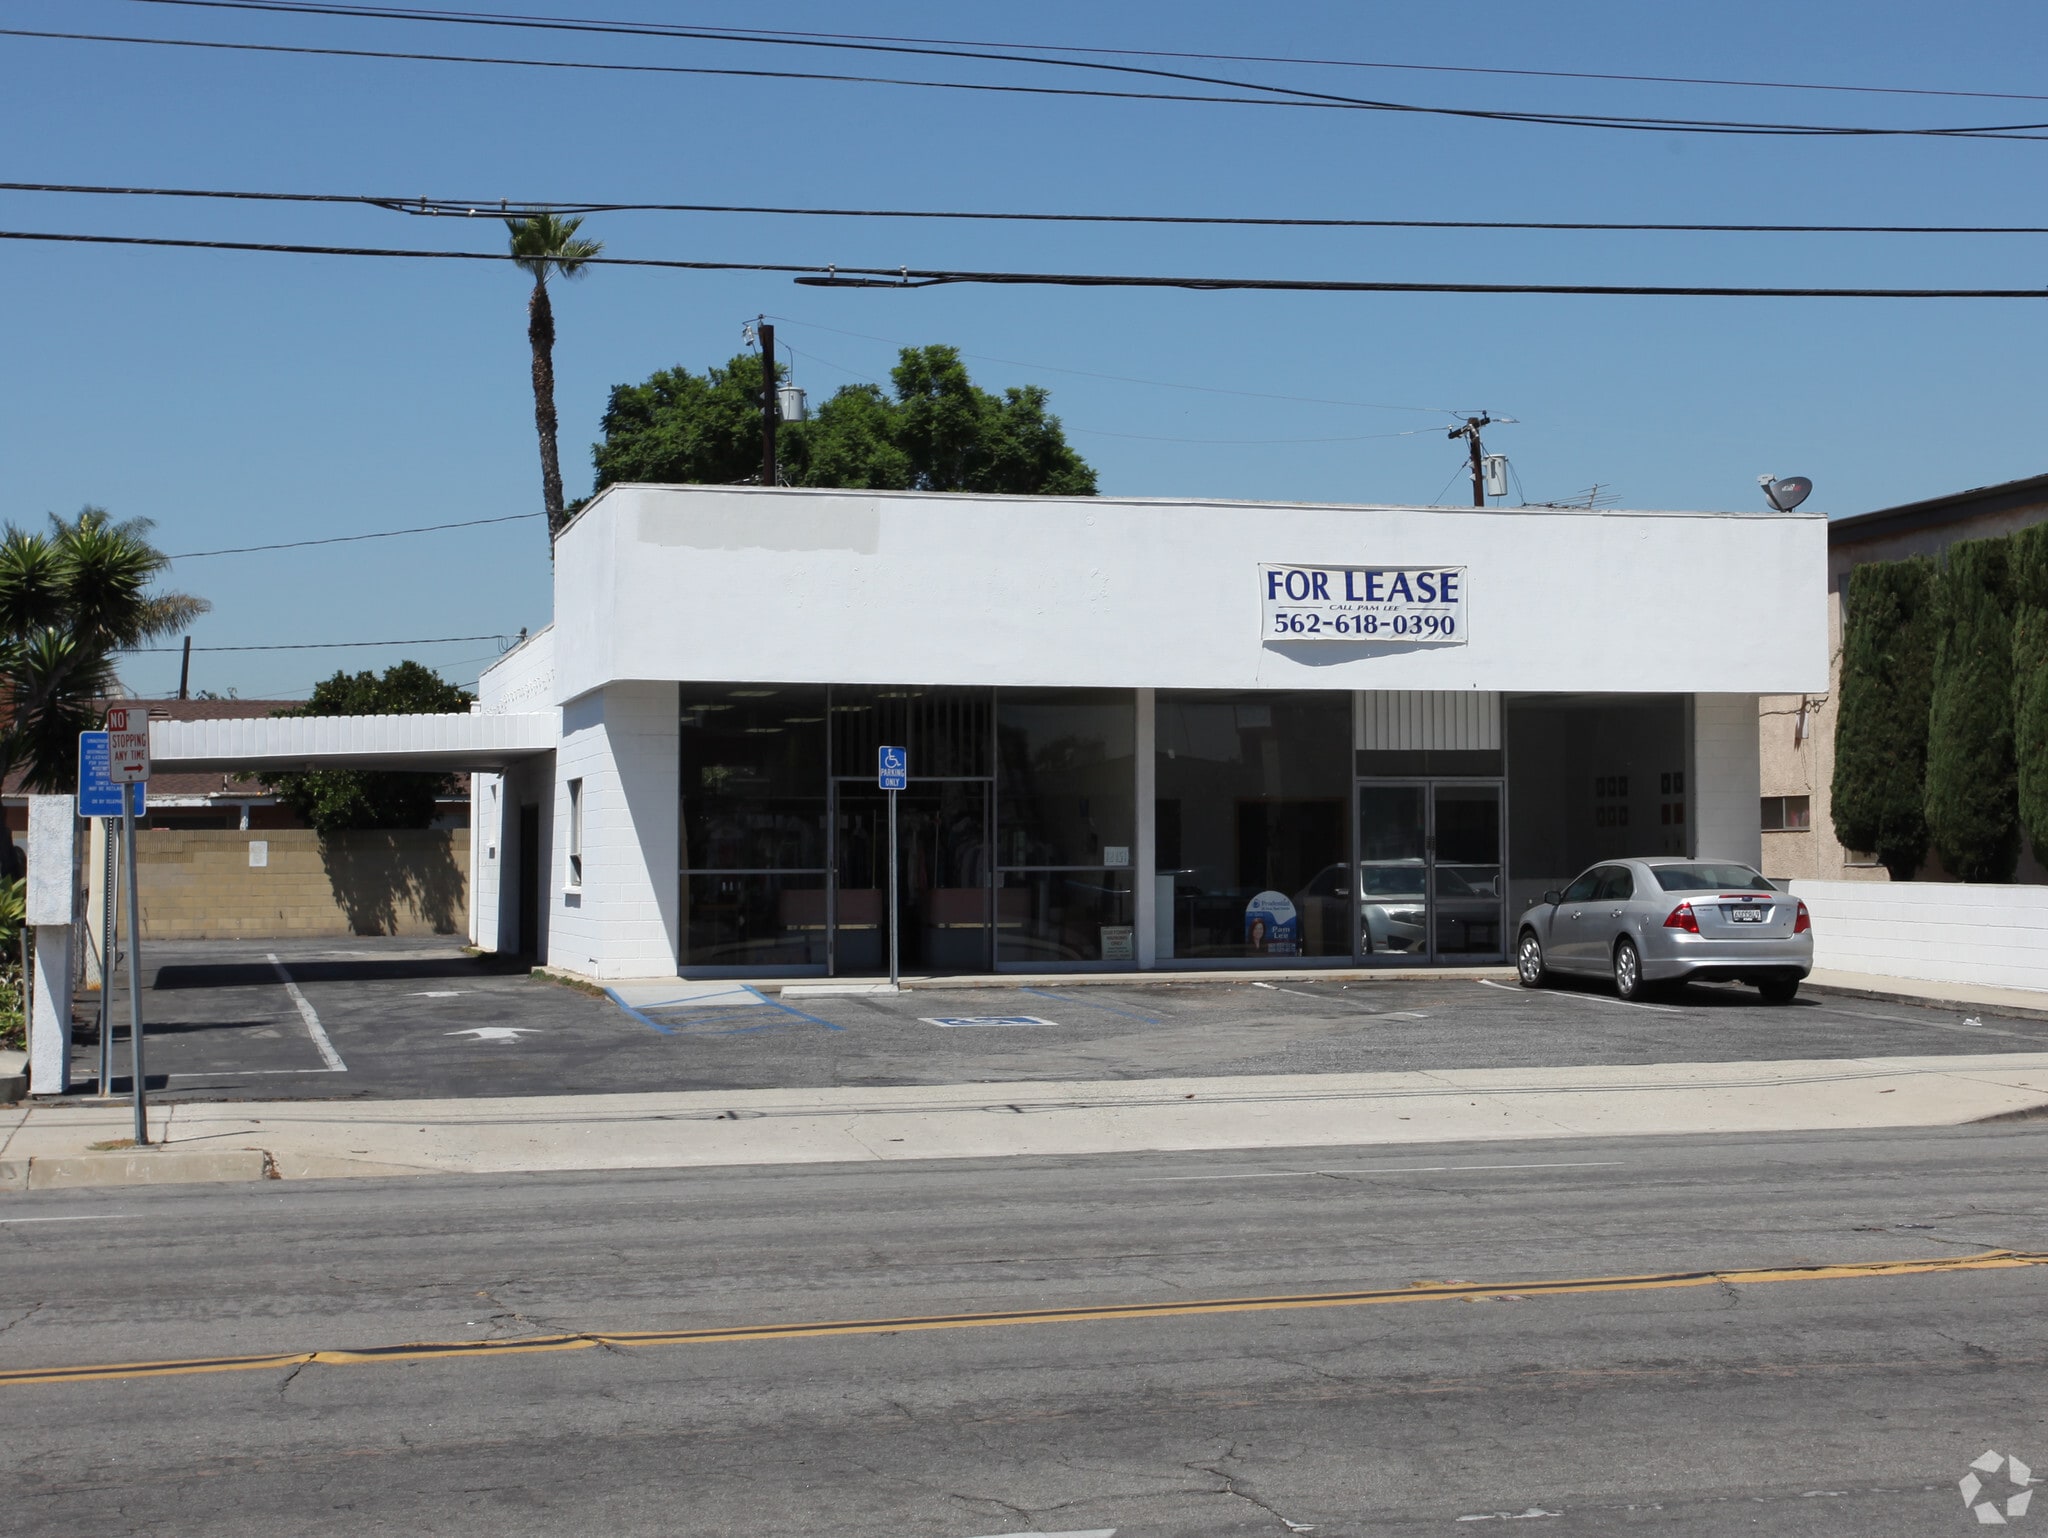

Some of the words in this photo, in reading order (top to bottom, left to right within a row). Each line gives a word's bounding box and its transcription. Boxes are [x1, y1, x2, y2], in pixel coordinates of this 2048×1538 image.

[1267, 570, 1331, 601] FOR
[1344, 571, 1459, 603] LEASE
[1274, 613, 1455, 635] 562-618-0390
[110, 711, 125, 728] NO
[112, 733, 146, 748] STOPPING
[115, 750, 128, 761] ANY
[131, 750, 145, 760] TIME
[880, 768, 905, 777] PARKING
[885, 778, 900, 787] ONLY
[1272, 925, 1290, 933] Pam
